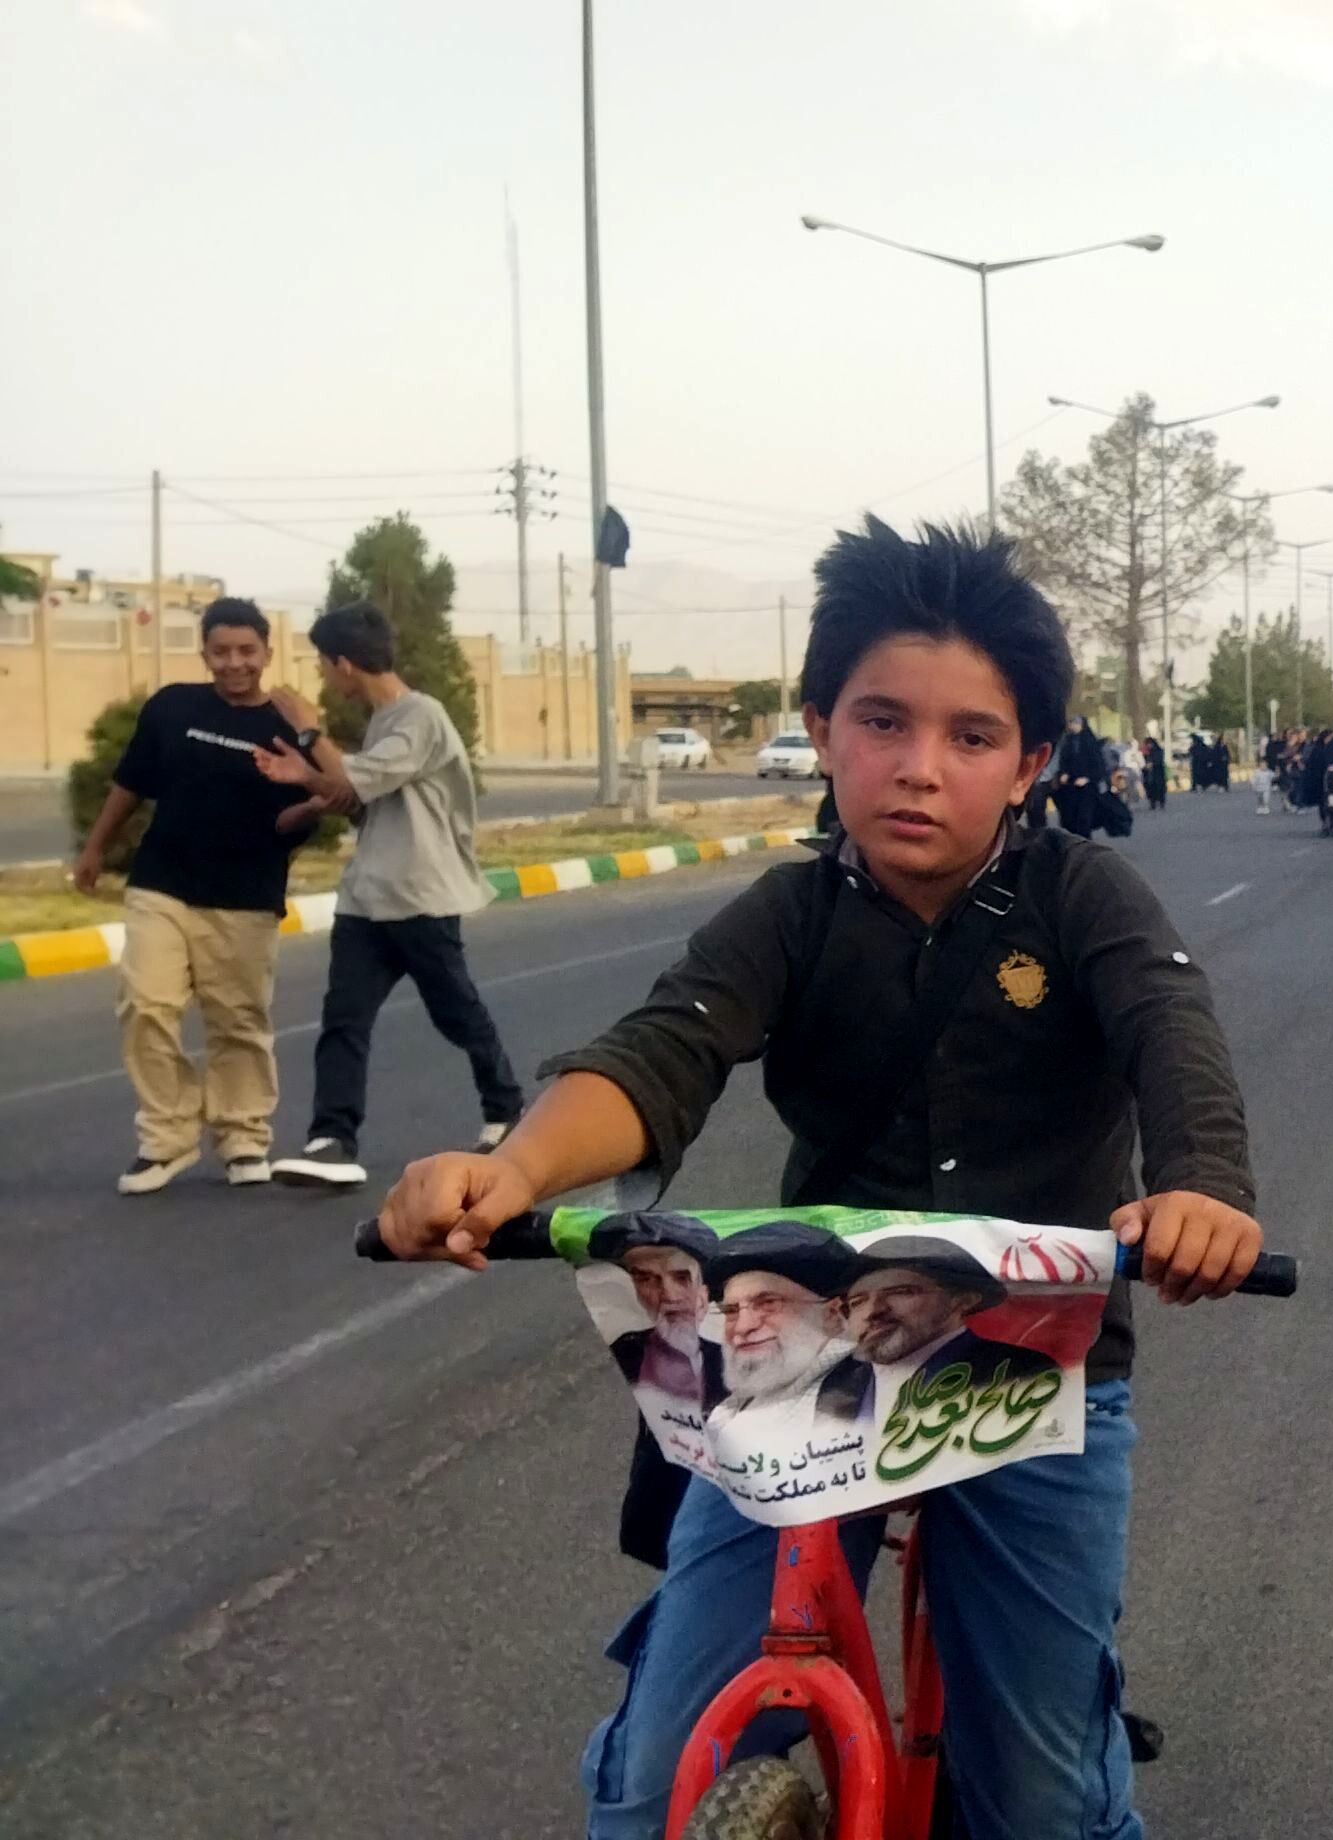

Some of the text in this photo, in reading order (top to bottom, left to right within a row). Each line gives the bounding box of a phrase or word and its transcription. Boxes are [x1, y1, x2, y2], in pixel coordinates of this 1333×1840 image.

[789, 1432, 864, 1471] پشتیبان
[719, 1451, 780, 1479] ولای
[852, 1460, 866, 1482] تا
[754, 1478, 826, 1503] مملکت
[830, 1471, 848, 1491] به
